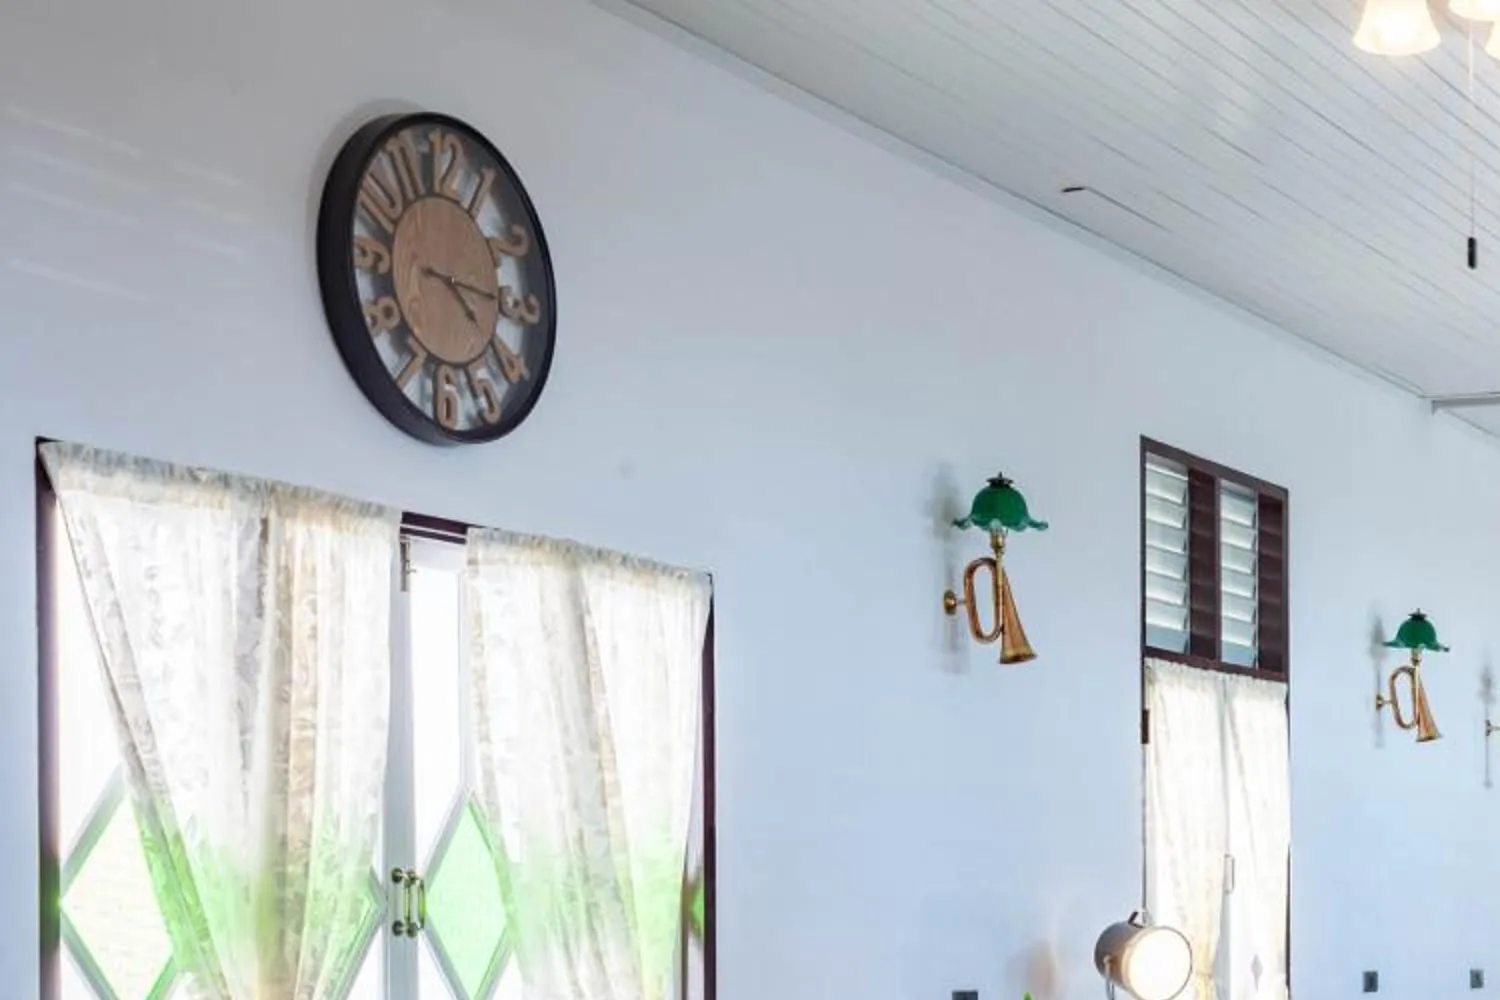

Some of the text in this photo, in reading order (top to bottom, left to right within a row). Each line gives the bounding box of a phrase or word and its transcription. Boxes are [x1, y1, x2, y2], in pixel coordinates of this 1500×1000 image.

[430, 128, 466, 202] 12
[469, 166, 496, 217] 1
[354, 235, 392, 275] 9
[488, 224, 530, 267] 2
[364, 296, 400, 335] 8
[498, 285, 541, 325] 3
[491, 339, 530, 383] 4
[433, 364, 459, 430] 6
[467, 354, 500, 424] 5
